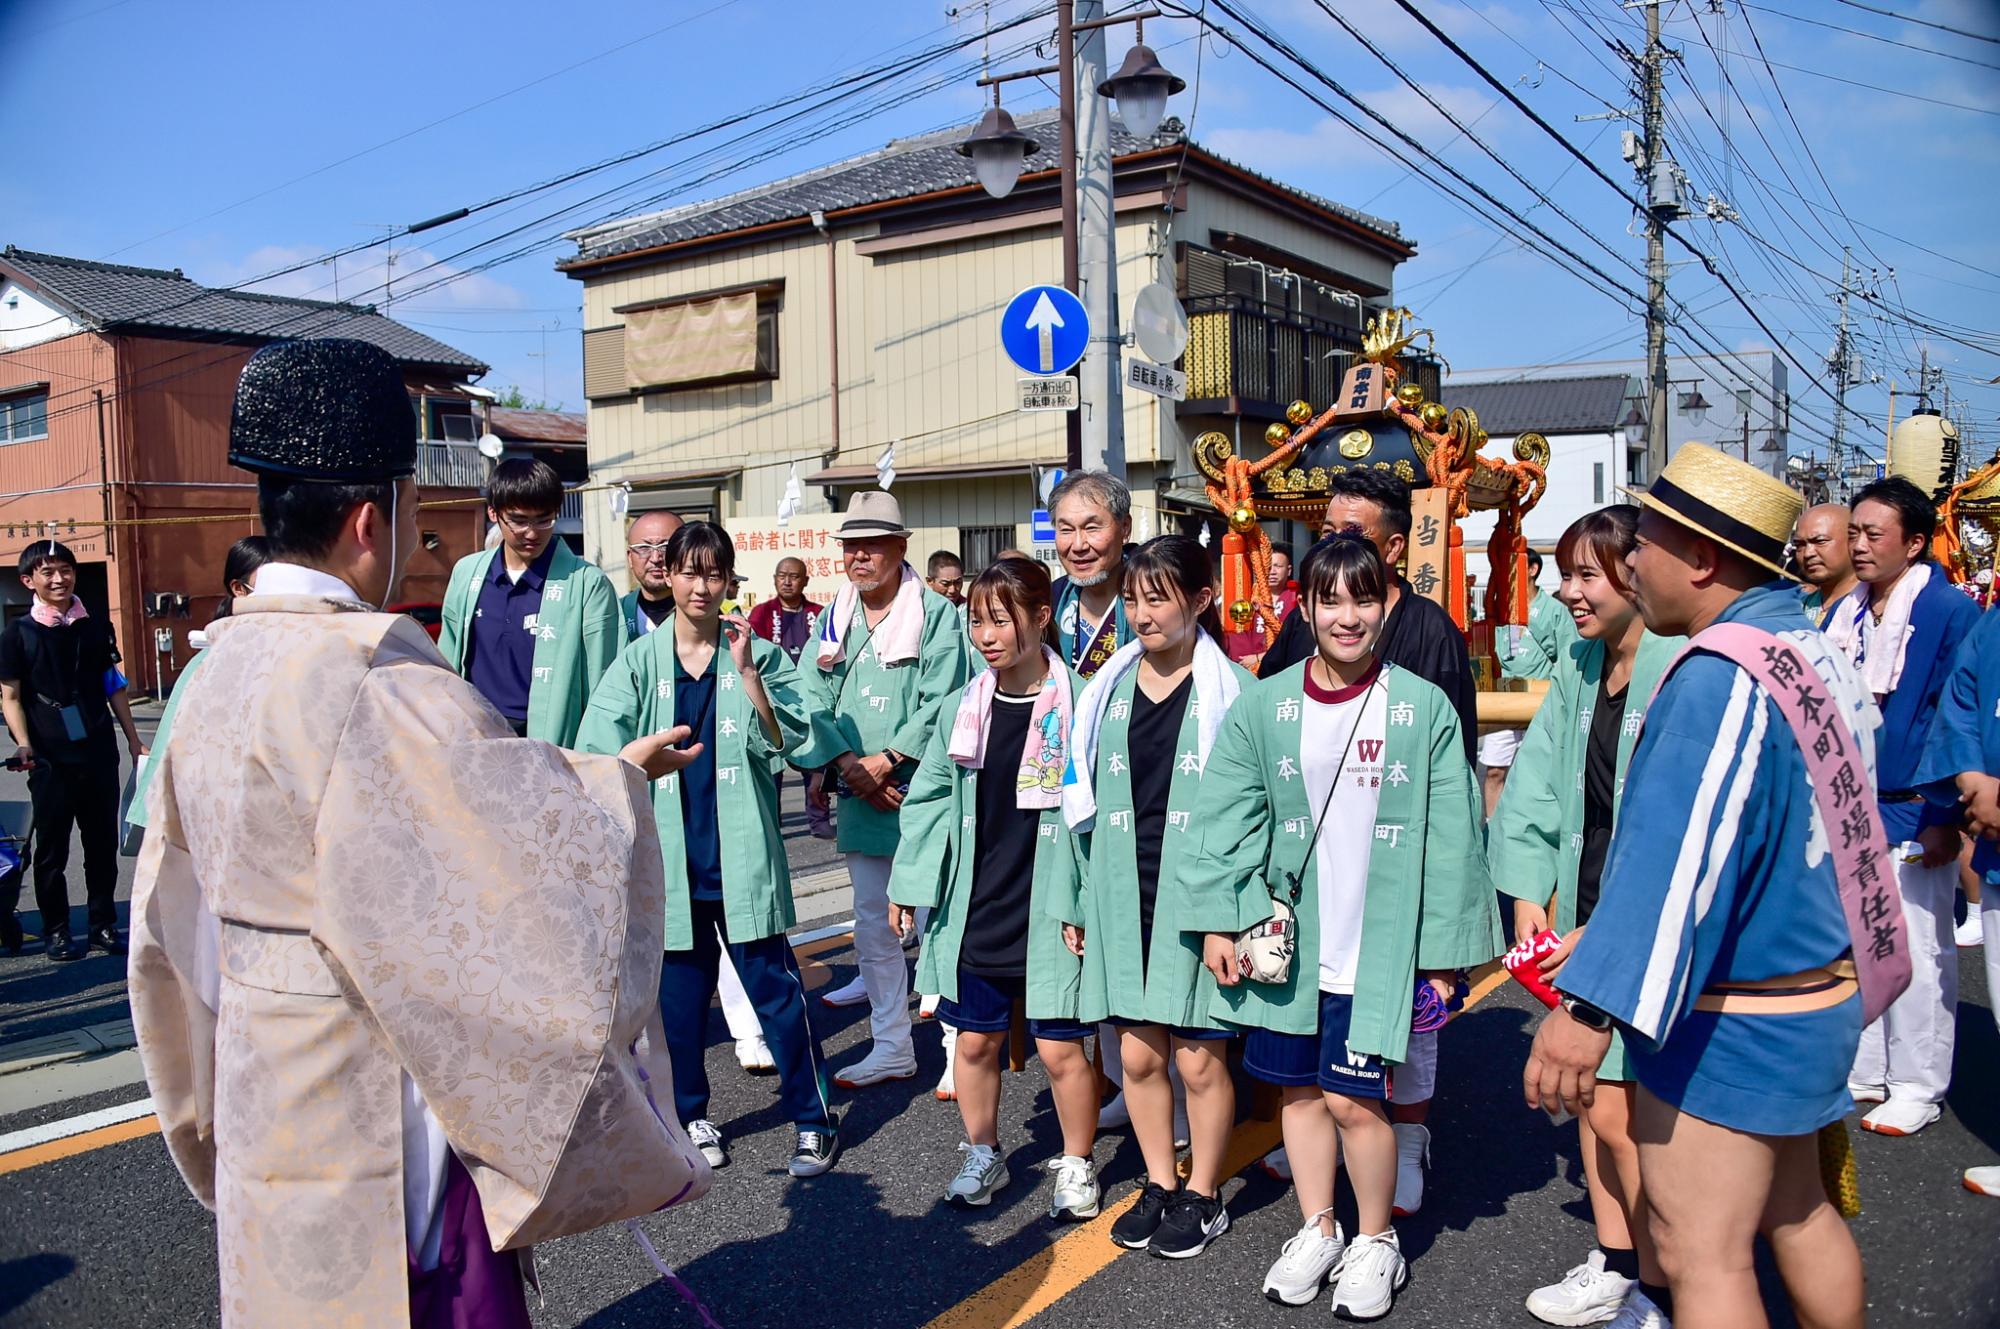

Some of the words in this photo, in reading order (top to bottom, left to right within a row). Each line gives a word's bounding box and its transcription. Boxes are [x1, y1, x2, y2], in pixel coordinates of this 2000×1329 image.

[1024, 381, 1071, 393] 一方通行出口
[1024, 395, 1072, 408] 自転車を除く
[1133, 364, 1180, 394] 自転車を除く
[1350, 366, 1372, 409] 南本町
[1412, 515, 1440, 594] 当番
[534, 584, 564, 684] 南本町
[719, 672, 739, 785] 南本町
[1107, 698, 1131, 833] 南本町
[1357, 739, 1383, 762] W
[1275, 697, 1309, 840] 南本町
[1375, 701, 1415, 848] 南本町
[1760, 646, 1898, 962] 南本町現場責任者
[1331, 1064, 1356, 1076] WASEDA
[1357, 1070, 1380, 1079] HONJO
